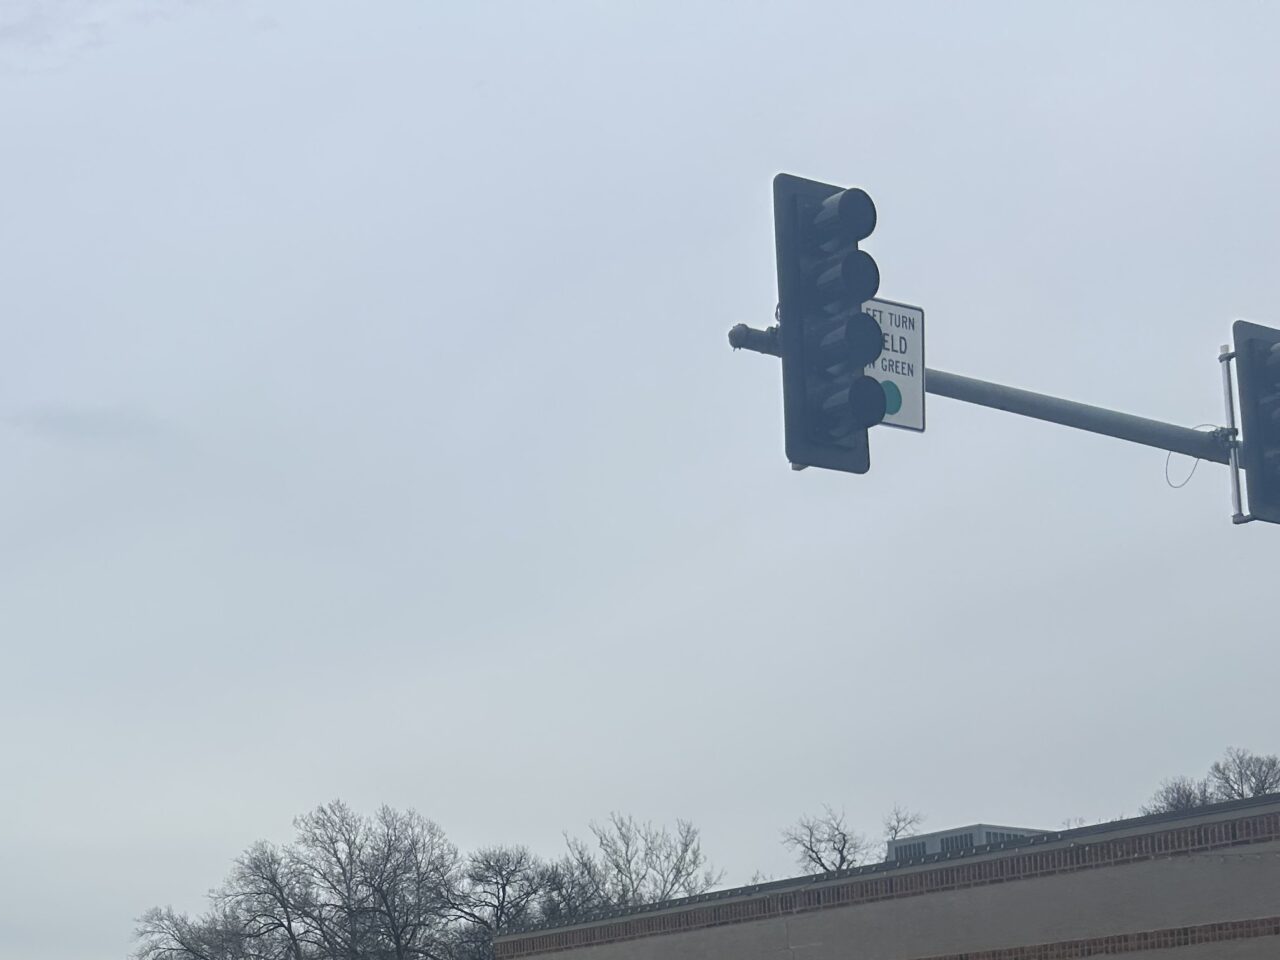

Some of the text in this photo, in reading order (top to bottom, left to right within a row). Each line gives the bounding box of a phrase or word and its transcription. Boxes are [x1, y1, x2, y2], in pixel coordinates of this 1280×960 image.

[888, 312, 915, 331] TURN
[882, 333, 908, 354] ELD
[881, 358, 914, 377] GREEN
